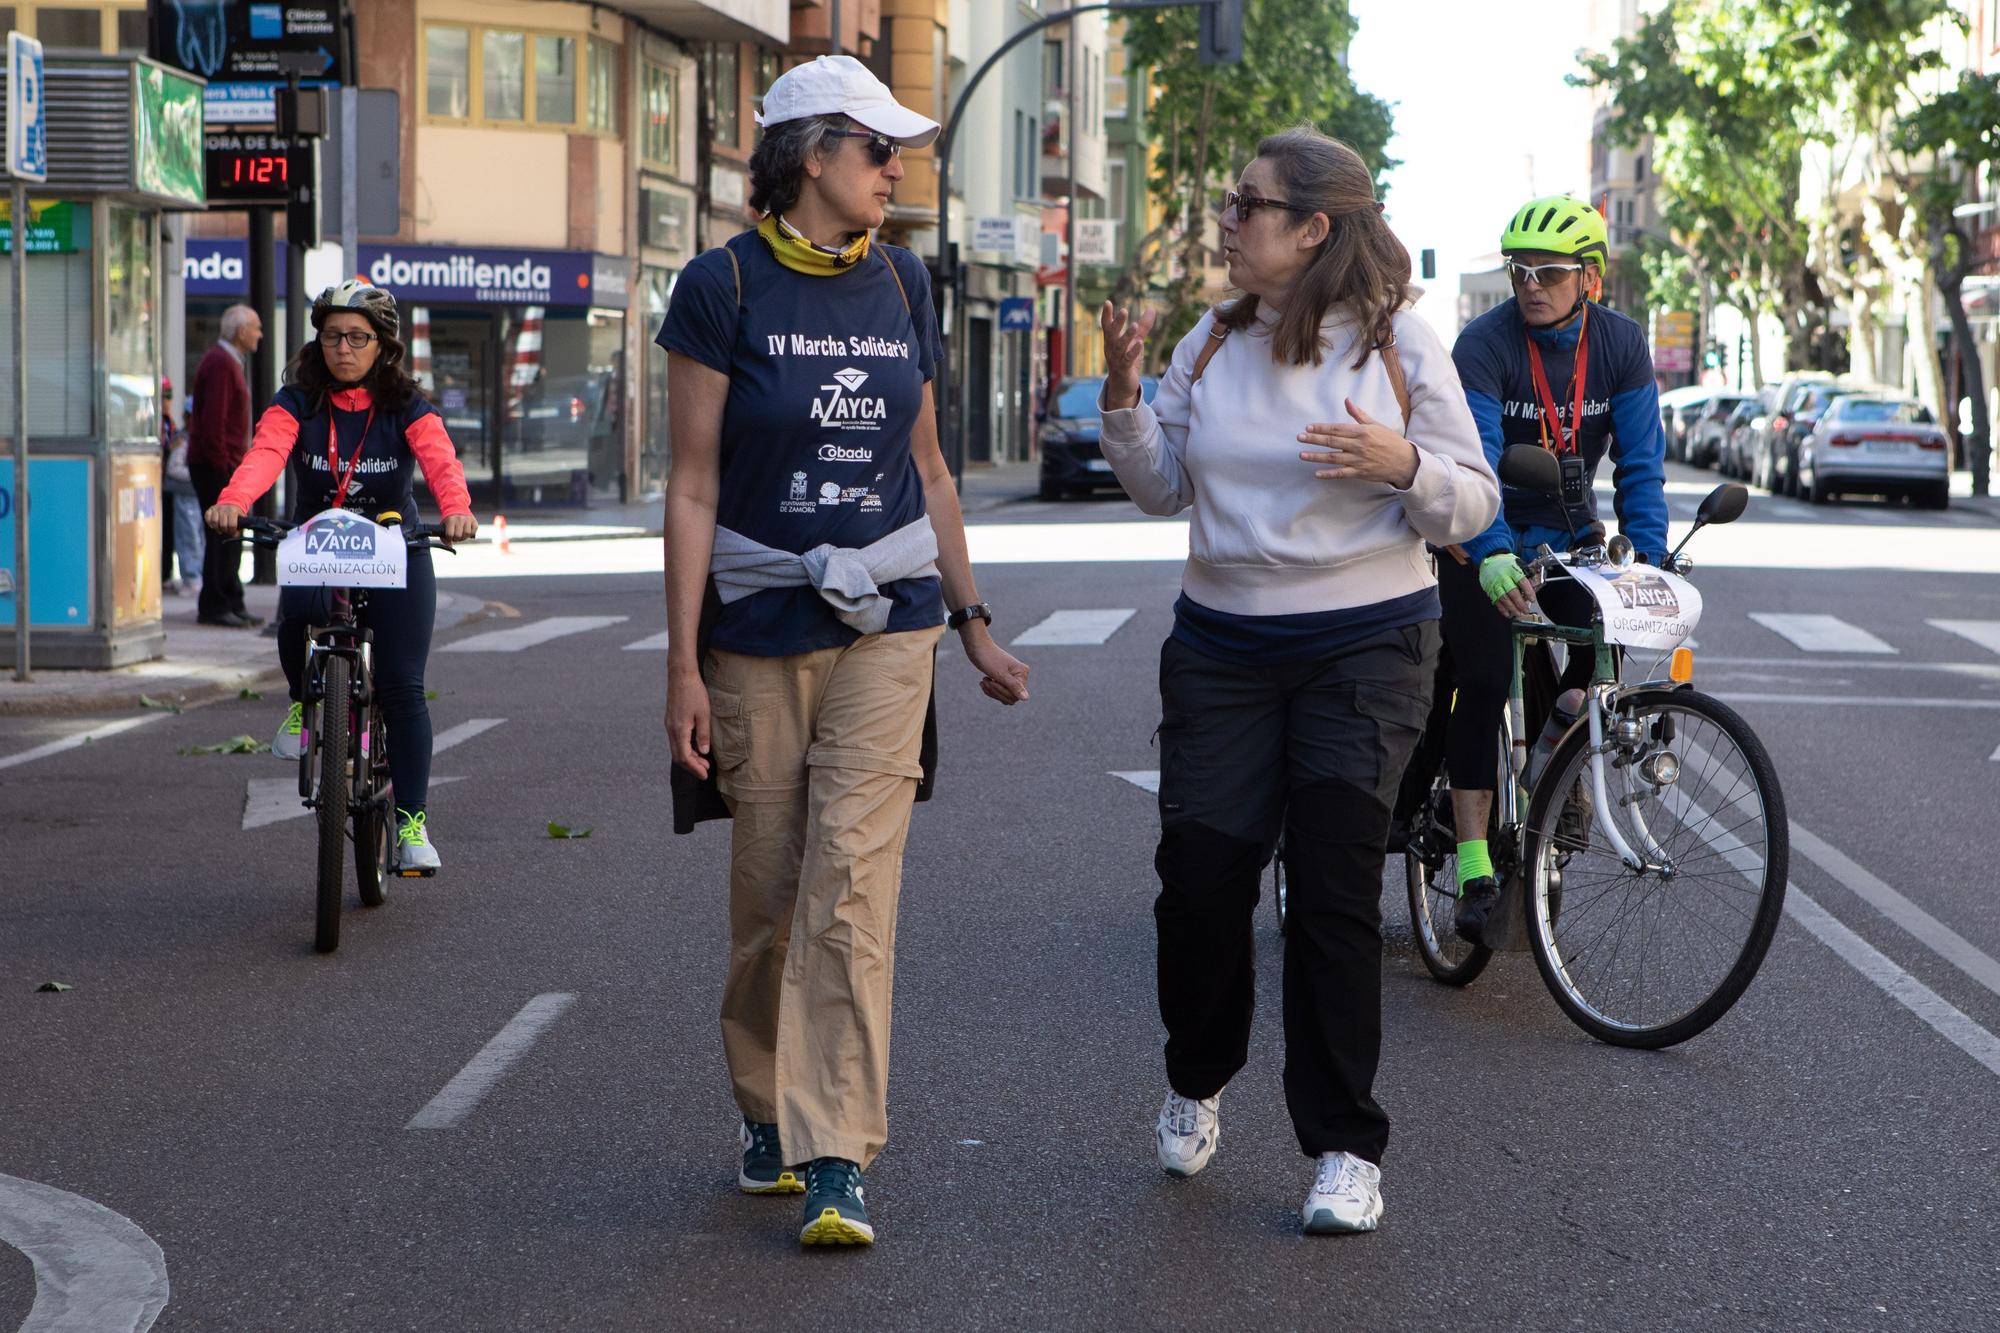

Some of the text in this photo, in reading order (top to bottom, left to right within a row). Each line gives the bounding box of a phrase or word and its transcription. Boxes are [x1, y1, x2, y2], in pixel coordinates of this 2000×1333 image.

[287, 22, 334, 34] Dentales
[20, 54, 39, 159] P
[371, 253, 550, 289] dormitienda
[767, 334, 909, 361] IV Marcha Solidaria
[810, 384, 887, 428] AZAYCA
[1503, 399, 1519, 417] IV
[818, 443, 873, 462] Cobadu
[354, 456, 399, 474] Solidaria
[788, 506, 816, 514] ZAMORA
[307, 528, 373, 554] AZAYCA
[288, 561, 397, 575] ORGANIZACIÓN
[1618, 582, 1677, 610] AZAYCA
[1613, 616, 1692, 637] ORGANIZACIÓN
